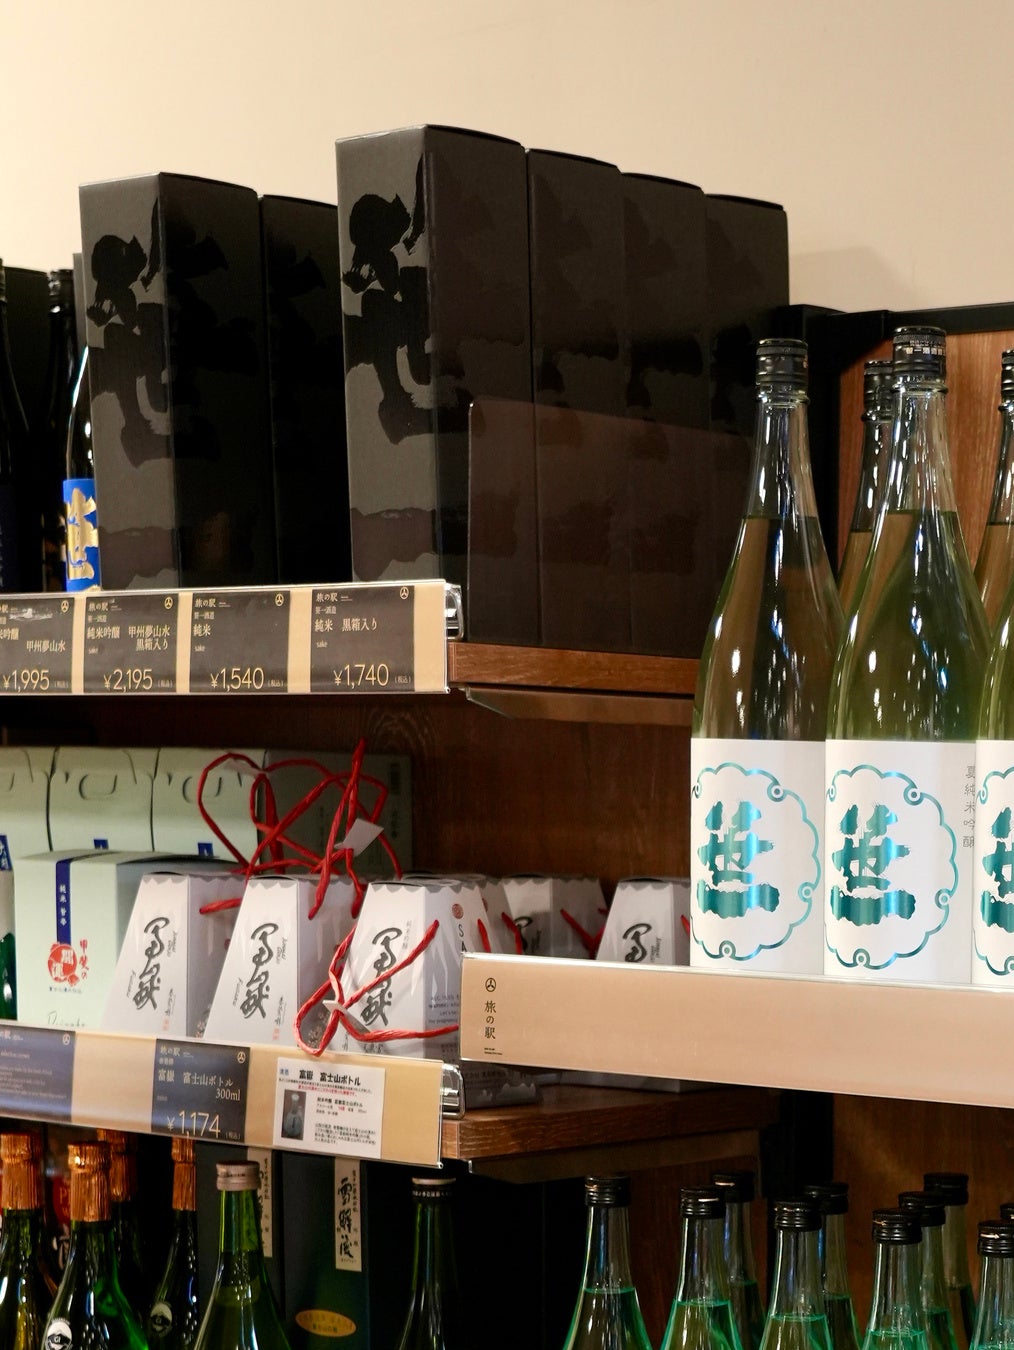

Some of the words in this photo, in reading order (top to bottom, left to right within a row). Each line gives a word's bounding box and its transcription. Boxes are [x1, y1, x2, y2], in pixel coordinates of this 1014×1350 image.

[193, 624, 211, 636] 純米
[315, 618, 333, 632] 純米
[341, 617, 378, 631] 黒箱入り
[87, 627, 120, 640] 純米吟醸
[128, 625, 170, 638] 甲州夢山水
[27, 640, 66, 653] 甲州夢山水
[136, 638, 168, 651] 黒箱入り
[3, 669, 50, 693] ¥1,995
[104, 668, 153, 693] ¥2,195
[210, 667, 264, 691] ¥1,540
[333, 663, 389, 689] ¥1,740
[484, 1000, 497, 1040] 旅の駅
[183, 1072, 234, 1087] 富士山ボトル
[319, 1072, 361, 1086] 富士山ボトル
[215, 1088, 241, 1101] 300ml
[167, 1110, 221, 1139] ¥1,174
